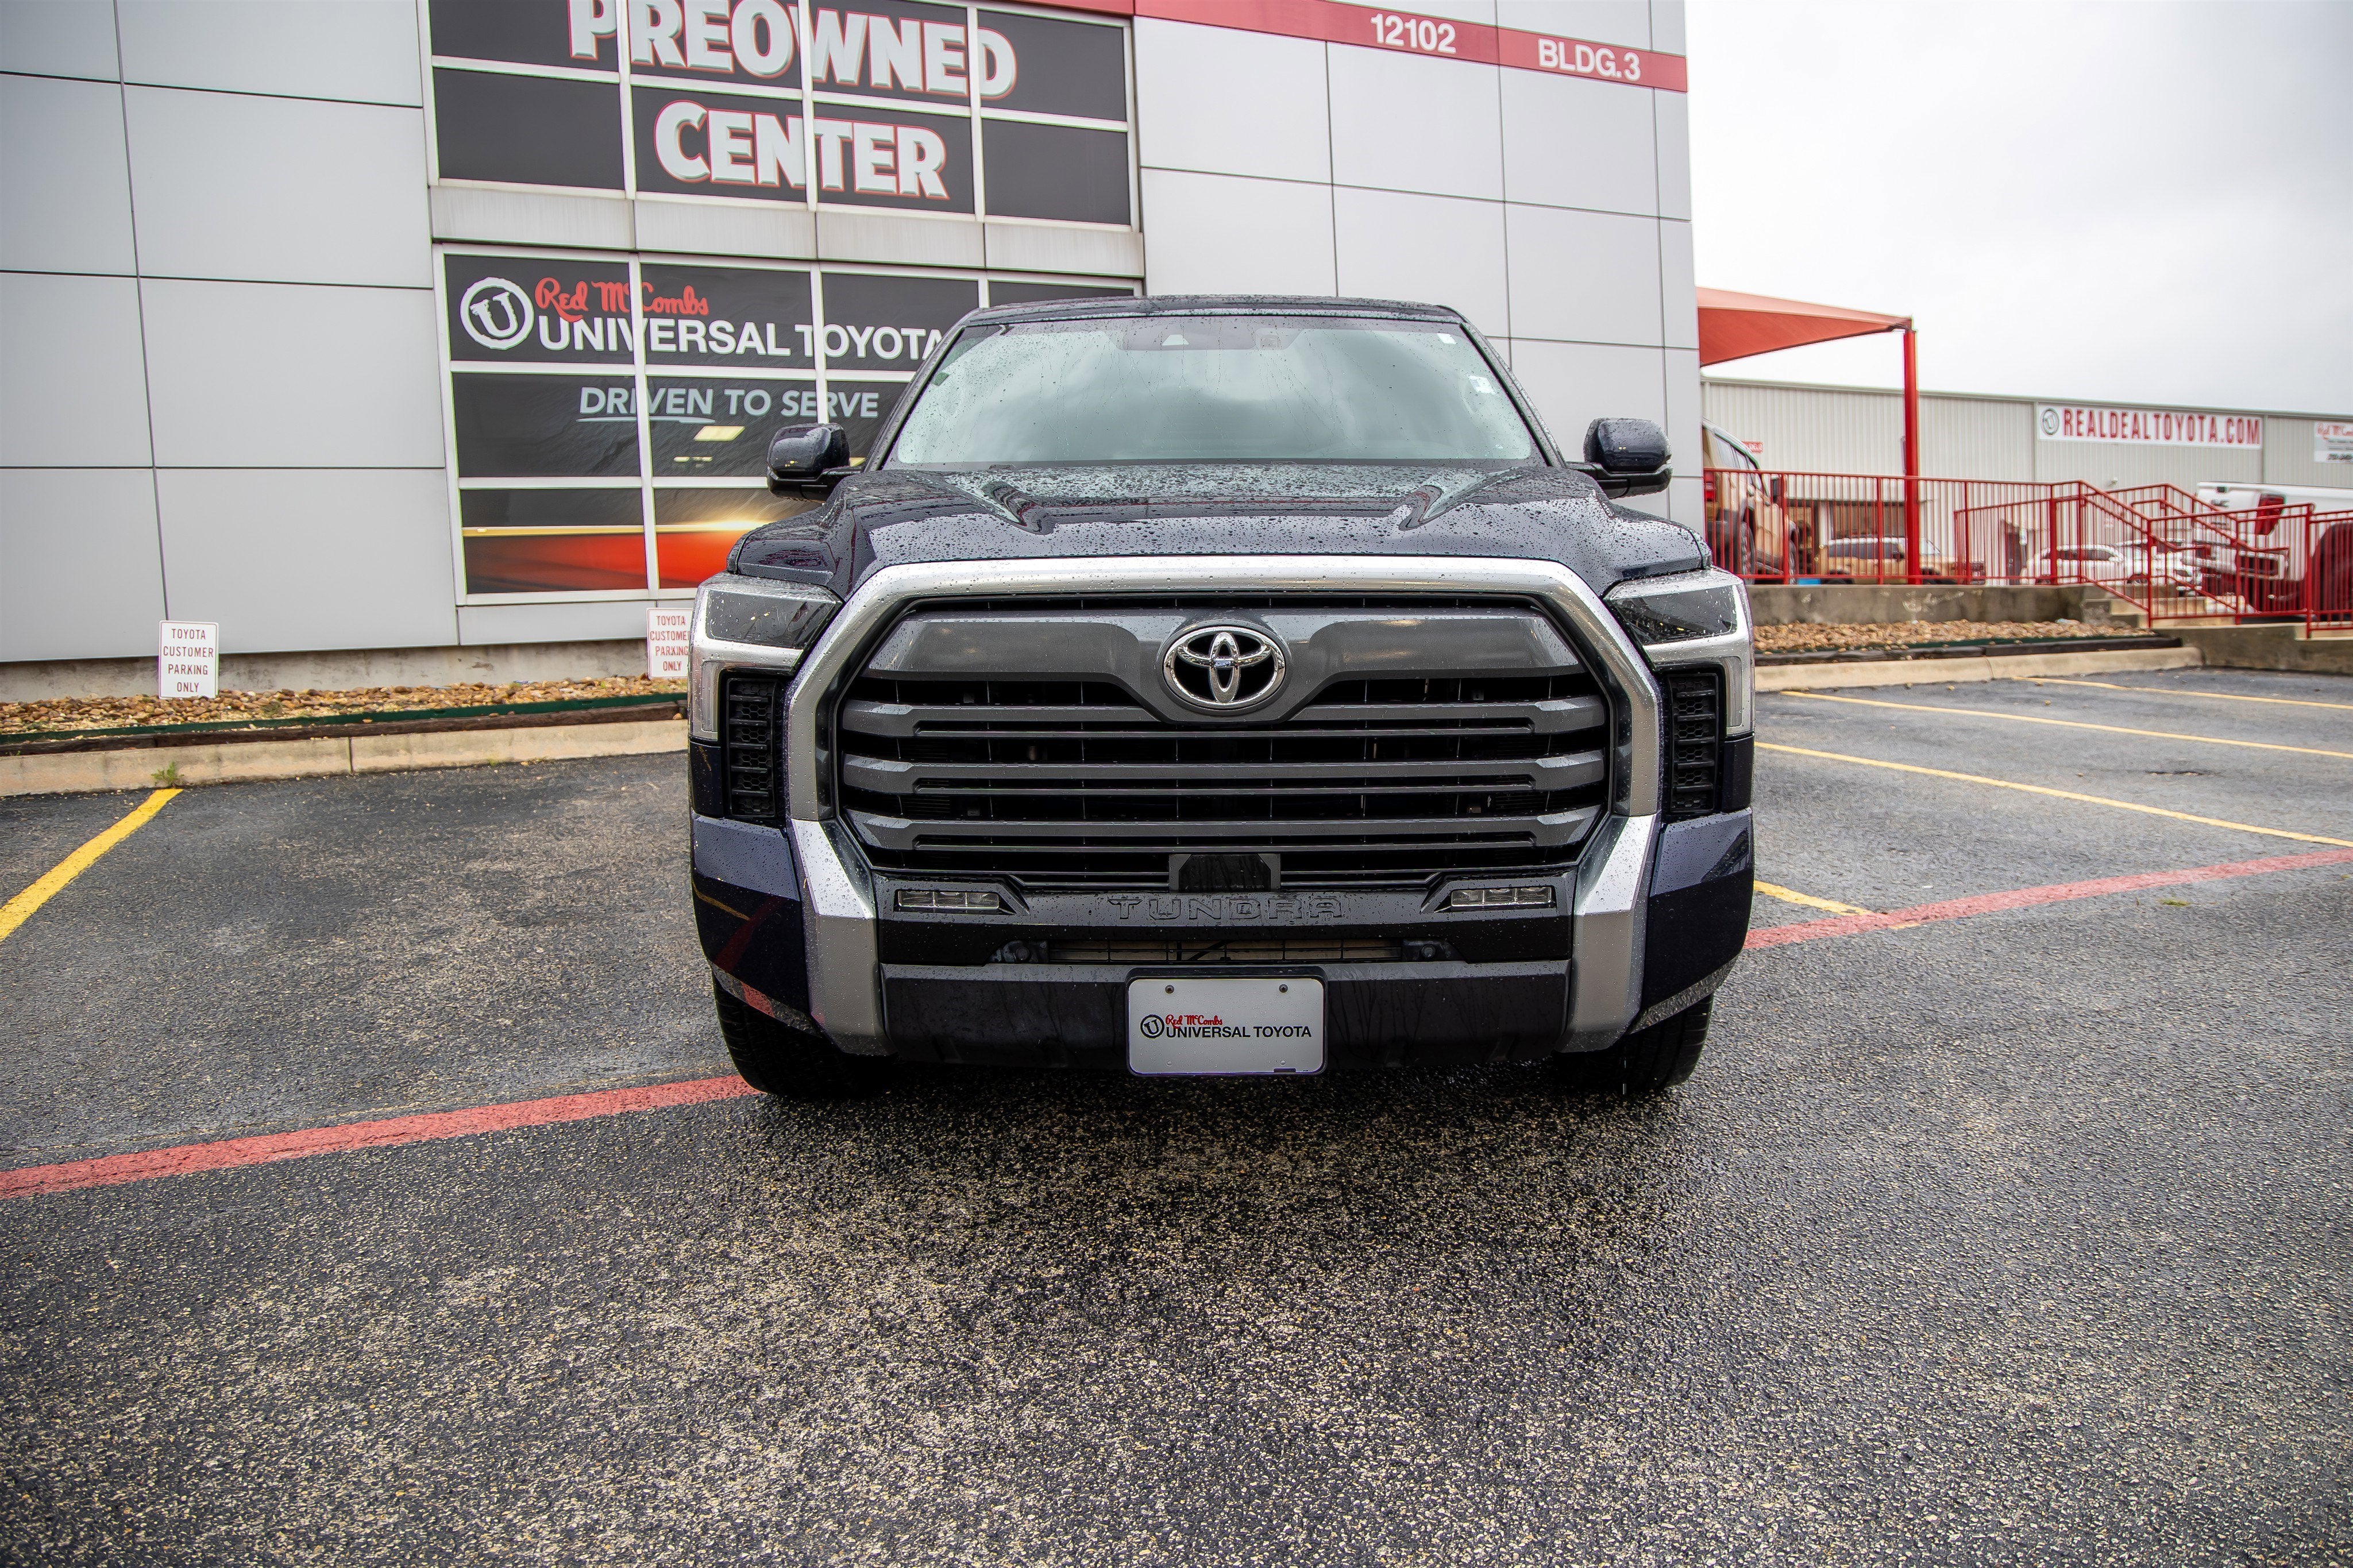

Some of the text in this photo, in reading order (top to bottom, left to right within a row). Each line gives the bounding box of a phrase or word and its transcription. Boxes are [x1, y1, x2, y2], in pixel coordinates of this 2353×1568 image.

[1371, 13, 1456, 53] 12102
[568, 0, 1017, 100] PREOWNED
[654, 99, 950, 200] CENTER
[535, 277, 589, 322] Red
[538, 315, 790, 357] UNIVERSAL
[580, 387, 880, 418] DRIVEN TO SERVE
[2063, 407, 2261, 446] REALDEALTOYOTA.COM
[656, 615, 686, 626] TOYOTA
[171, 628, 206, 640] TOYOTA
[163, 646, 214, 658] CUSTOMER
[168, 664, 208, 675] PARKING
[663, 661, 682, 671] ONLY
[177, 682, 199, 693] ONLY
[1107, 898, 1343, 920] TUNDRA
[1165, 1014, 1222, 1029] Red McCombs
[1166, 1026, 1312, 1038] UNIVERSAL TOYOTA
